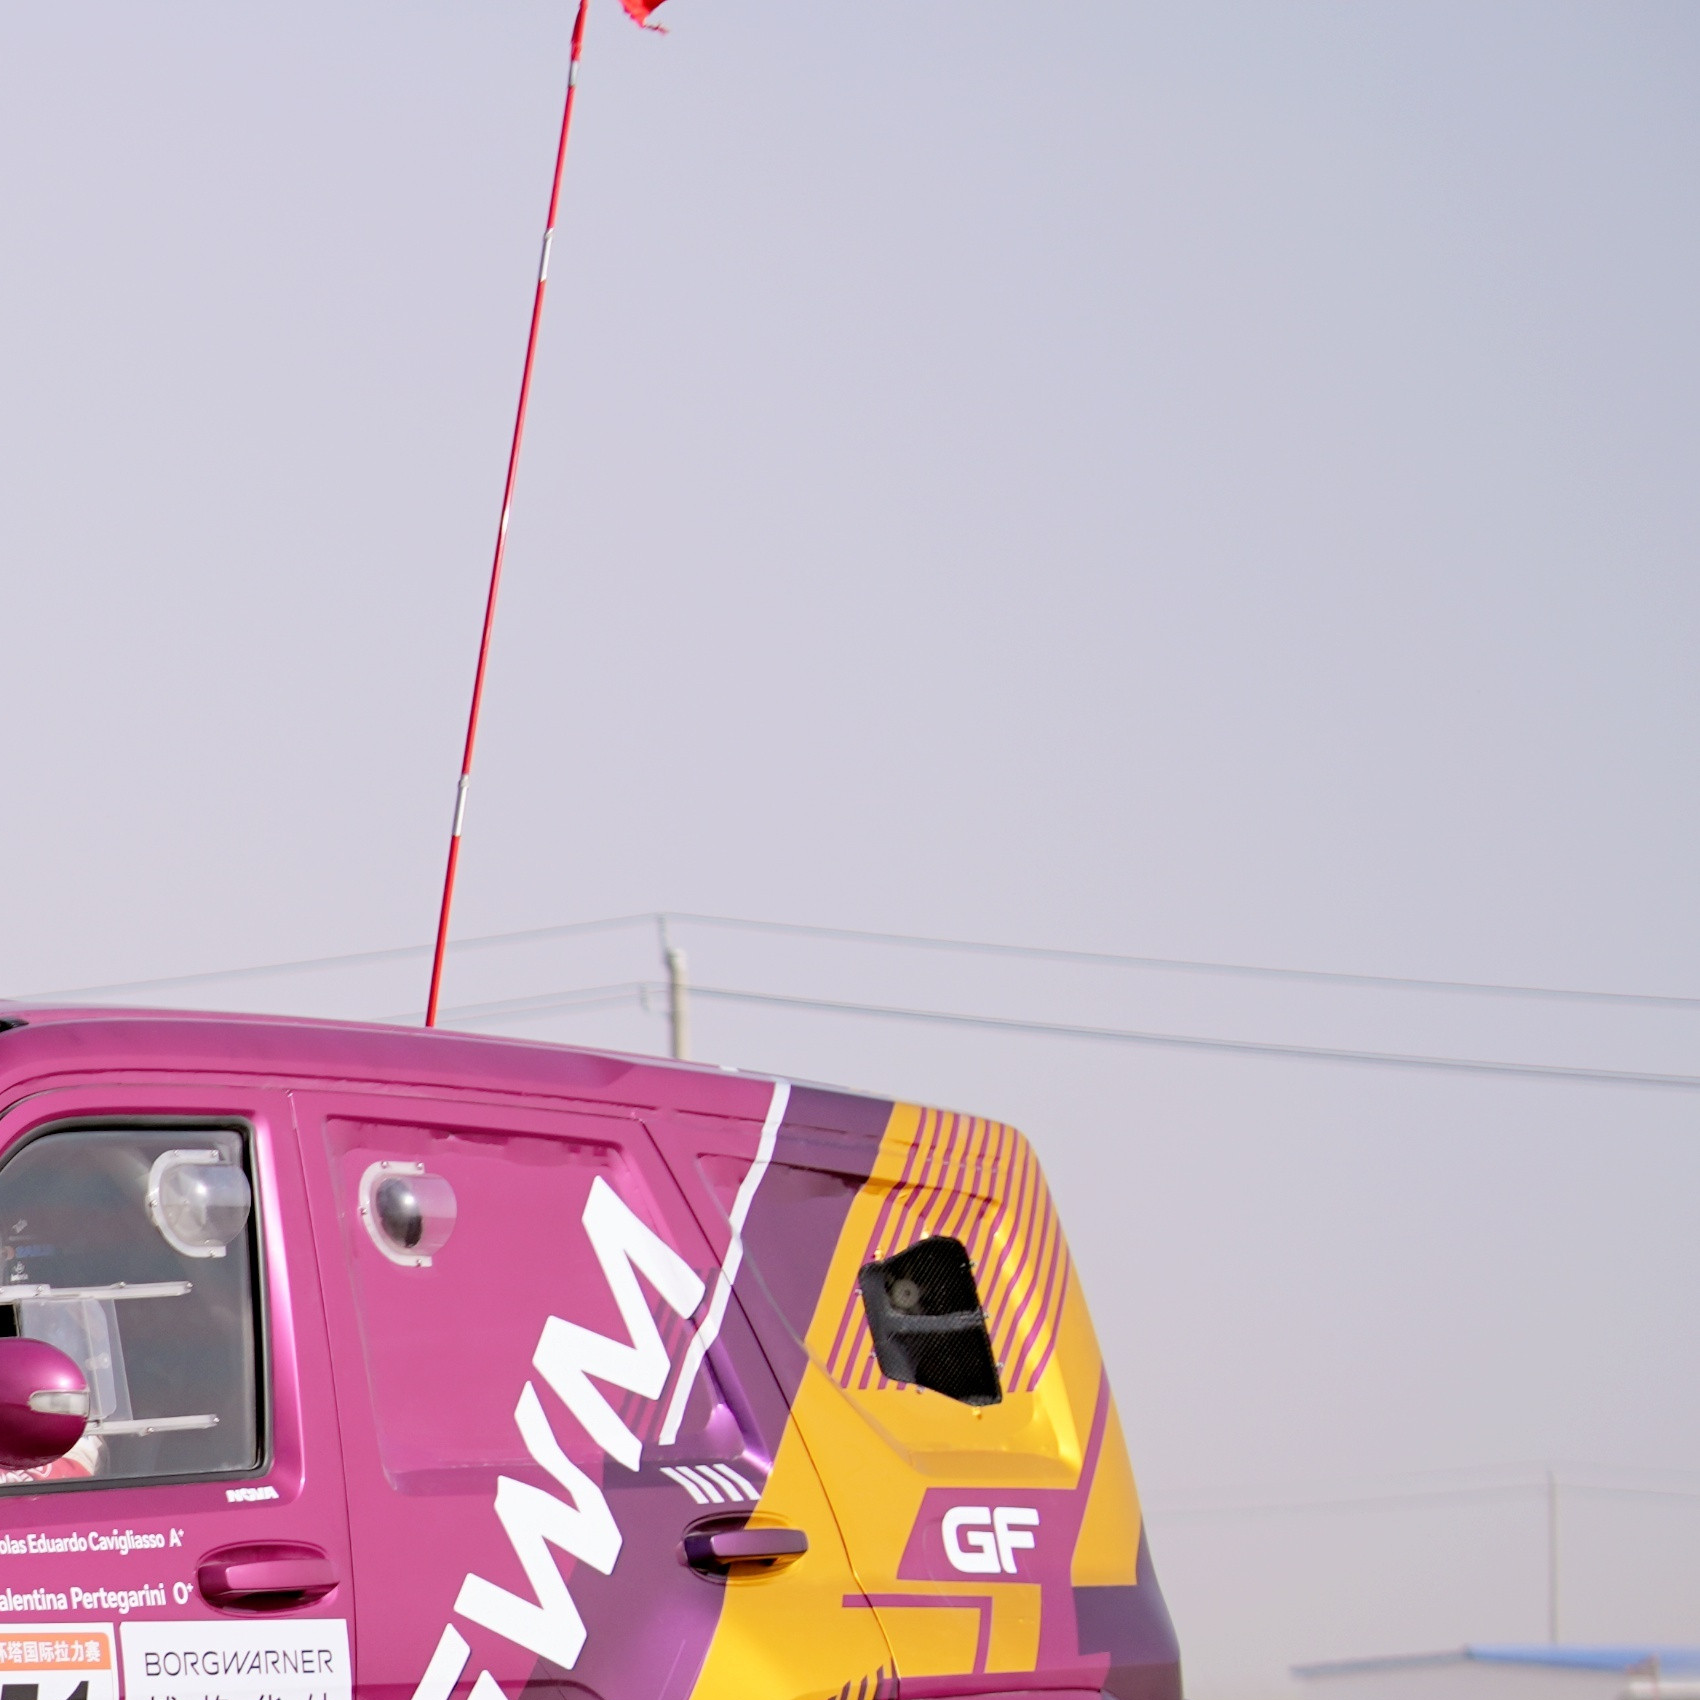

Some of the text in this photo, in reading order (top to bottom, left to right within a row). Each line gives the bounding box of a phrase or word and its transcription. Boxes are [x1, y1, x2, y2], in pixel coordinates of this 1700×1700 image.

[28, 1532, 88, 1553] Eduardo
[88, 1530, 166, 1556] Cavigliasso
[942, 1506, 1041, 1574] GF
[70, 1582, 167, 1614] Pertegarini
[144, 1650, 334, 1676] BORGWARNER
